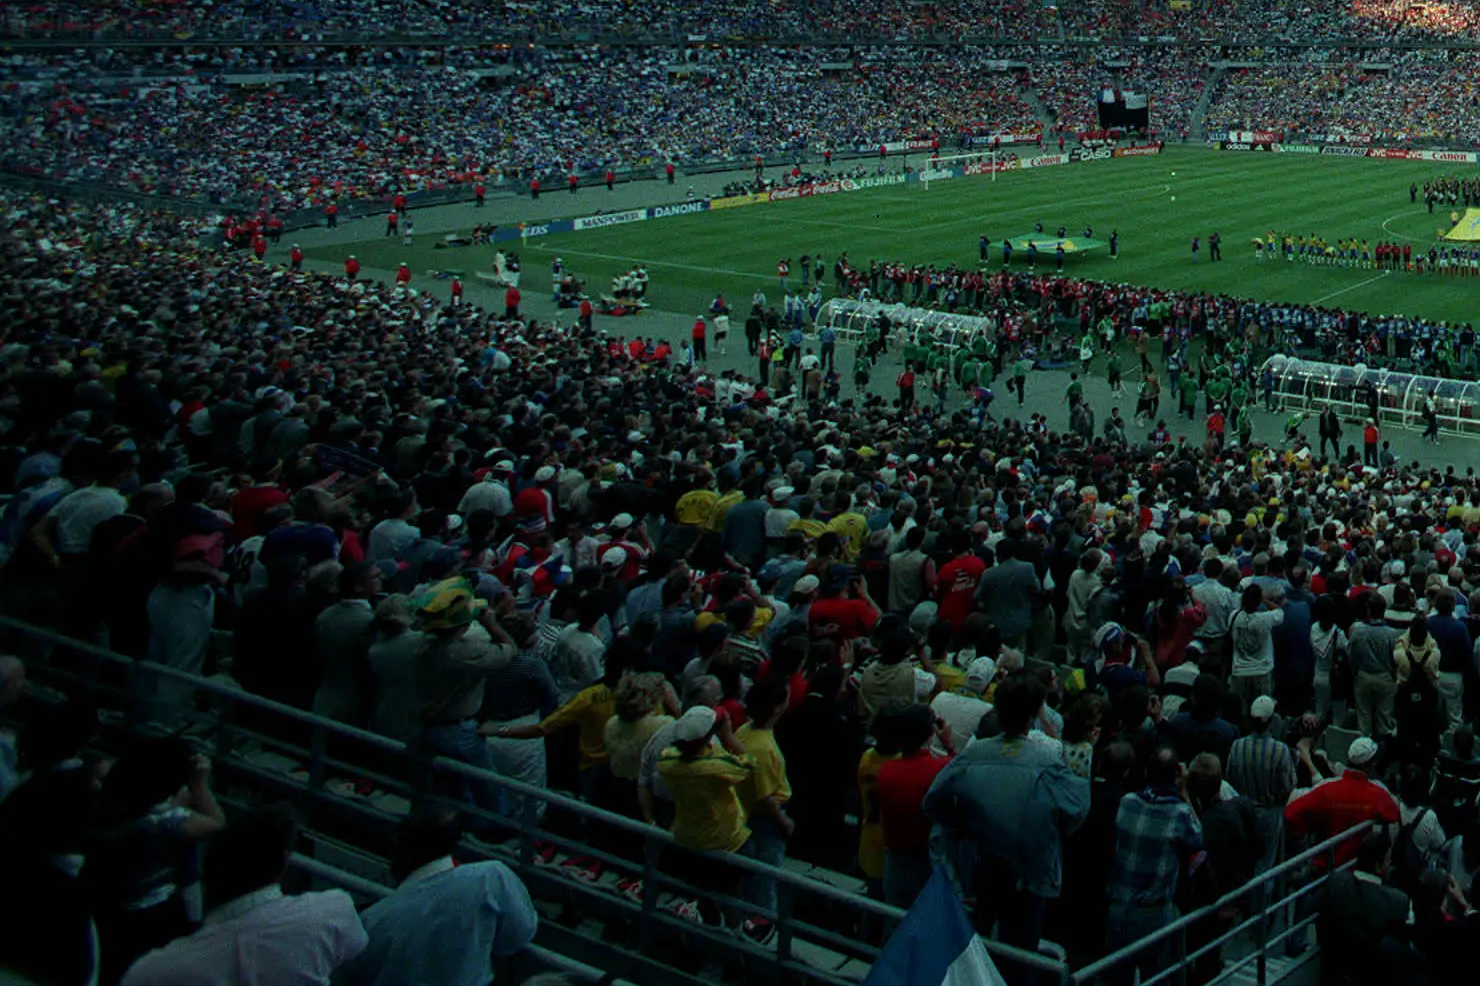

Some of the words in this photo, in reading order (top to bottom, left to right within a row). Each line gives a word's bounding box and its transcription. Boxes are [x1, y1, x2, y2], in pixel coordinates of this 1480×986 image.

[1226, 142, 1251, 151] adidas
[1080, 149, 1112, 162] CASIO
[1370, 149, 1386, 158] JVC
[1406, 150, 1422, 159] JVC
[1432, 151, 1467, 162] Canon
[1031, 155, 1061, 167] Canon
[654, 201, 704, 218] DANONE
[582, 212, 639, 228] MANPOWER
